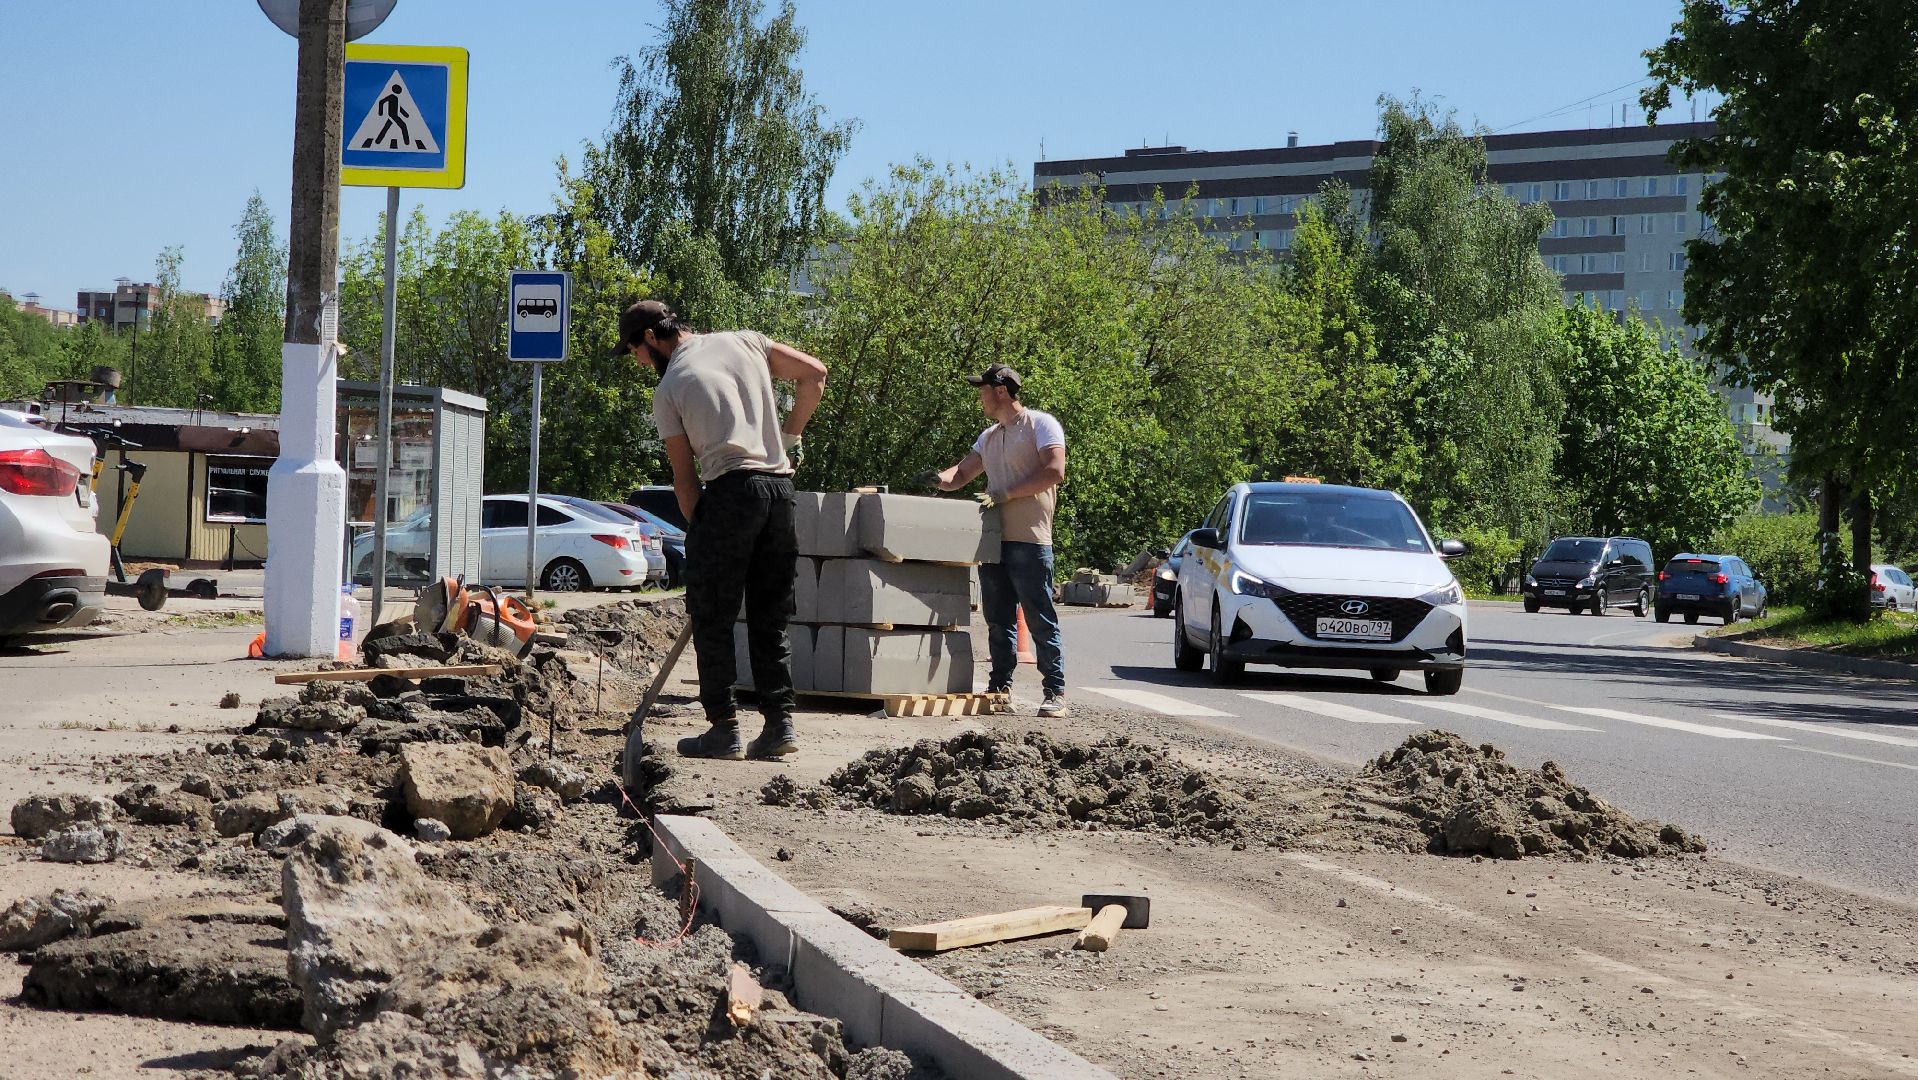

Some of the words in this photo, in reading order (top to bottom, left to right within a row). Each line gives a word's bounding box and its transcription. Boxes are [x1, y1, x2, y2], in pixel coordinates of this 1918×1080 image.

[209, 467, 246, 475] РИТУАЛЬНАЯ
[249, 468, 270, 476] СЛУЖБ
[1371, 621, 1389, 632] 797
